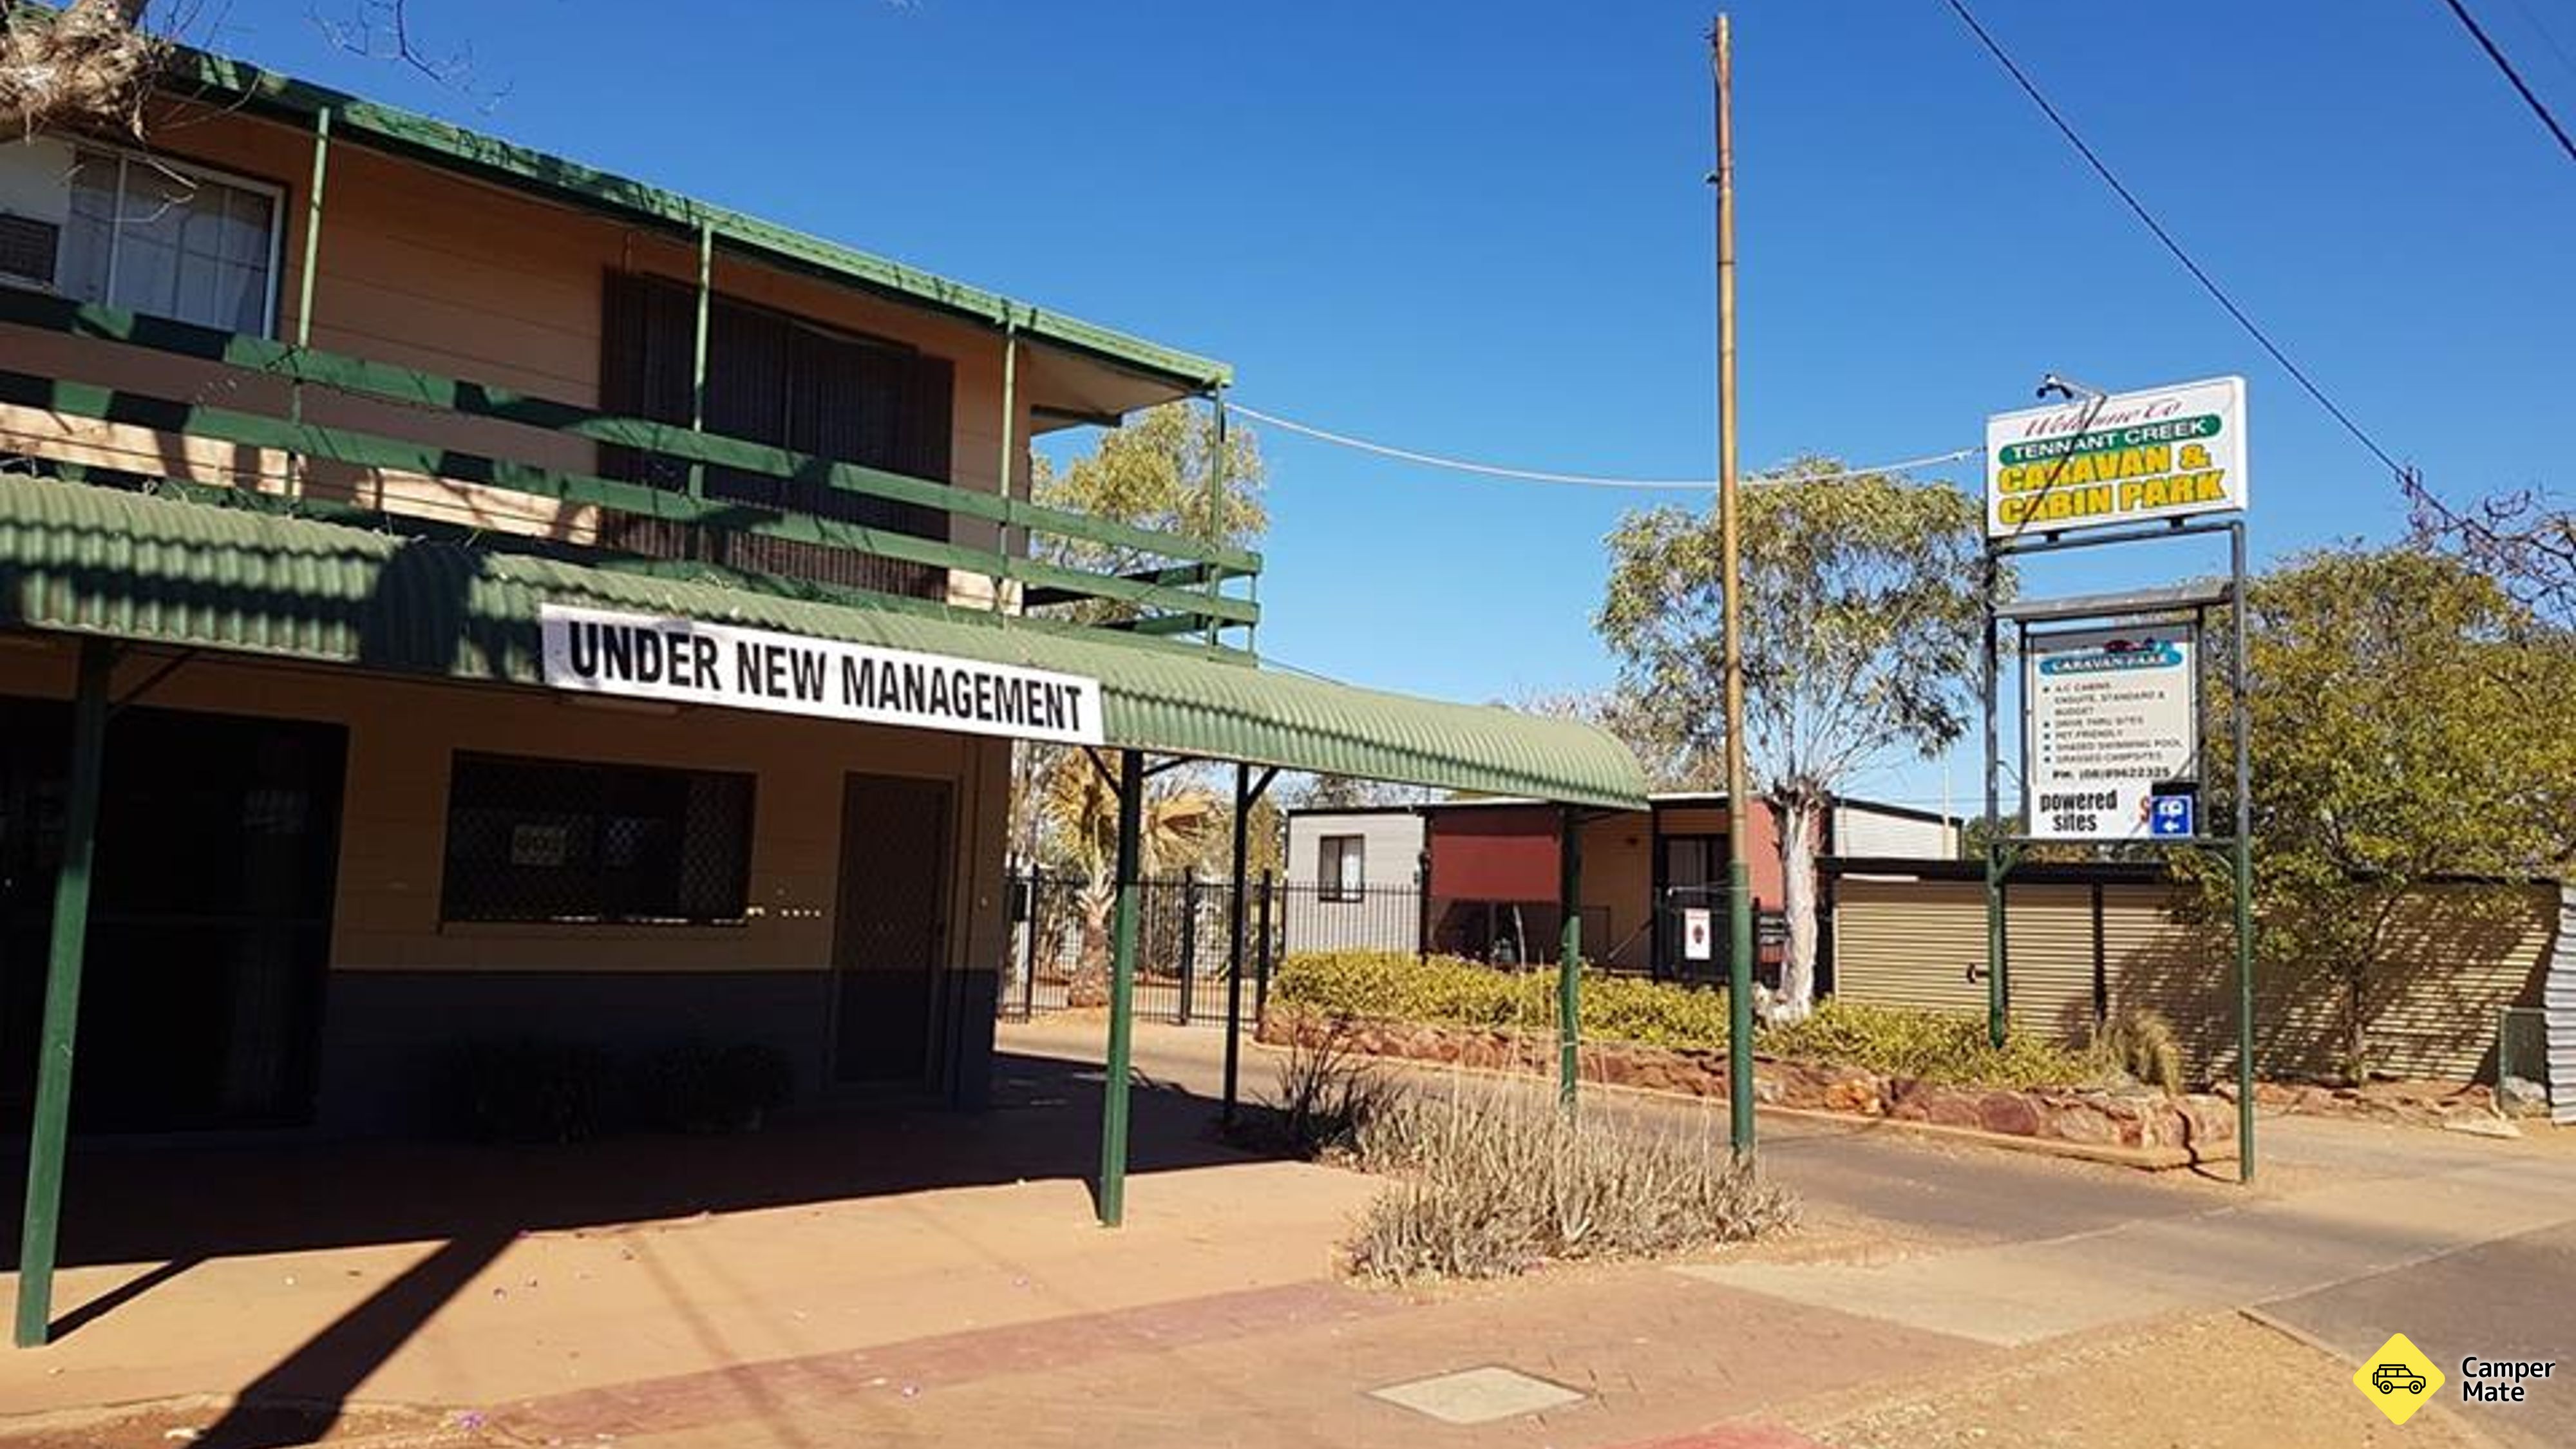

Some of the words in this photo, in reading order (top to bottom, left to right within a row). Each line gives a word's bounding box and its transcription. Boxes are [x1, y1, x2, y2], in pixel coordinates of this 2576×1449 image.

[2012, 433, 2119, 460] TENNANT
[2125, 419, 2208, 445] CREEK
[1998, 444, 2172, 493] CARAVAN
[2179, 444, 2211, 470] &
[1999, 486, 2112, 525] CABIN
[2119, 469, 2225, 511] PARK
[569, 620, 721, 692] UNDER
[736, 641, 827, 703] NEW
[840, 655, 1083, 733] MANAGEMENT
[2040, 790, 2117, 812] powered
[2052, 814, 2097, 831] sites
